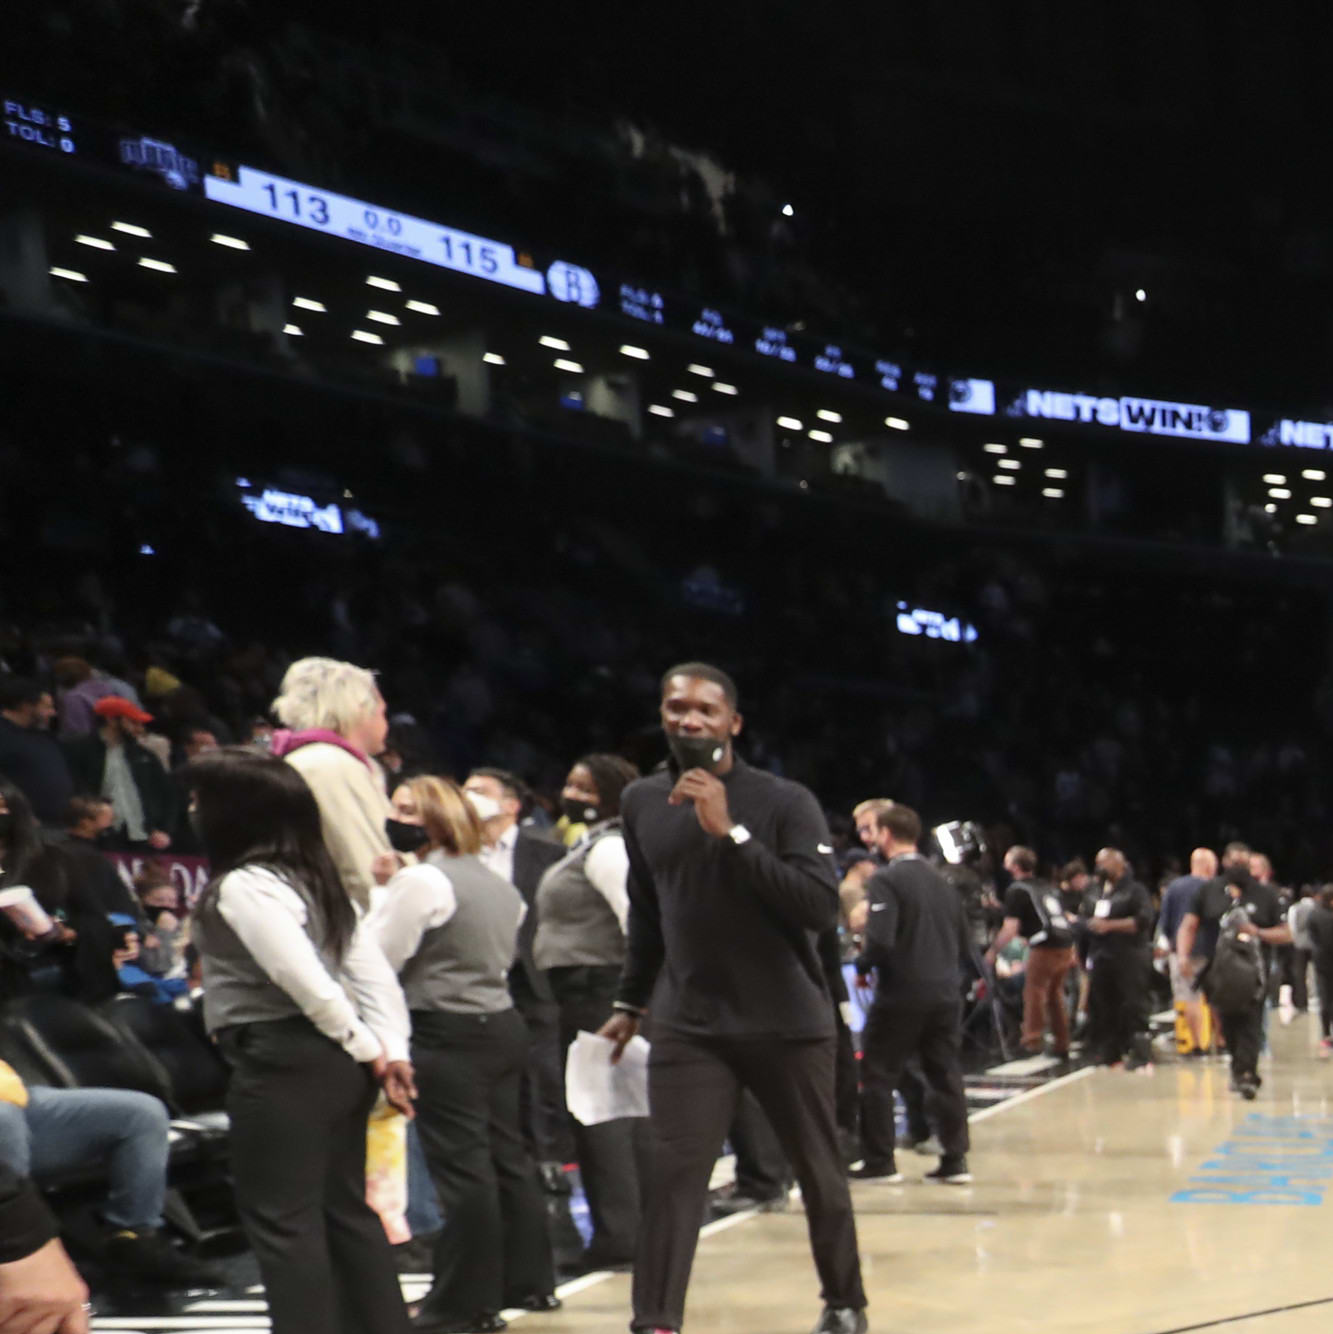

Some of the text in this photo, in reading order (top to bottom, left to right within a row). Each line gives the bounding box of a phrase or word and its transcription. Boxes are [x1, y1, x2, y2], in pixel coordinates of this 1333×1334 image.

[262, 182, 331, 225] 113
[439, 235, 498, 274] 115
[1026, 388, 1120, 426] NETS
